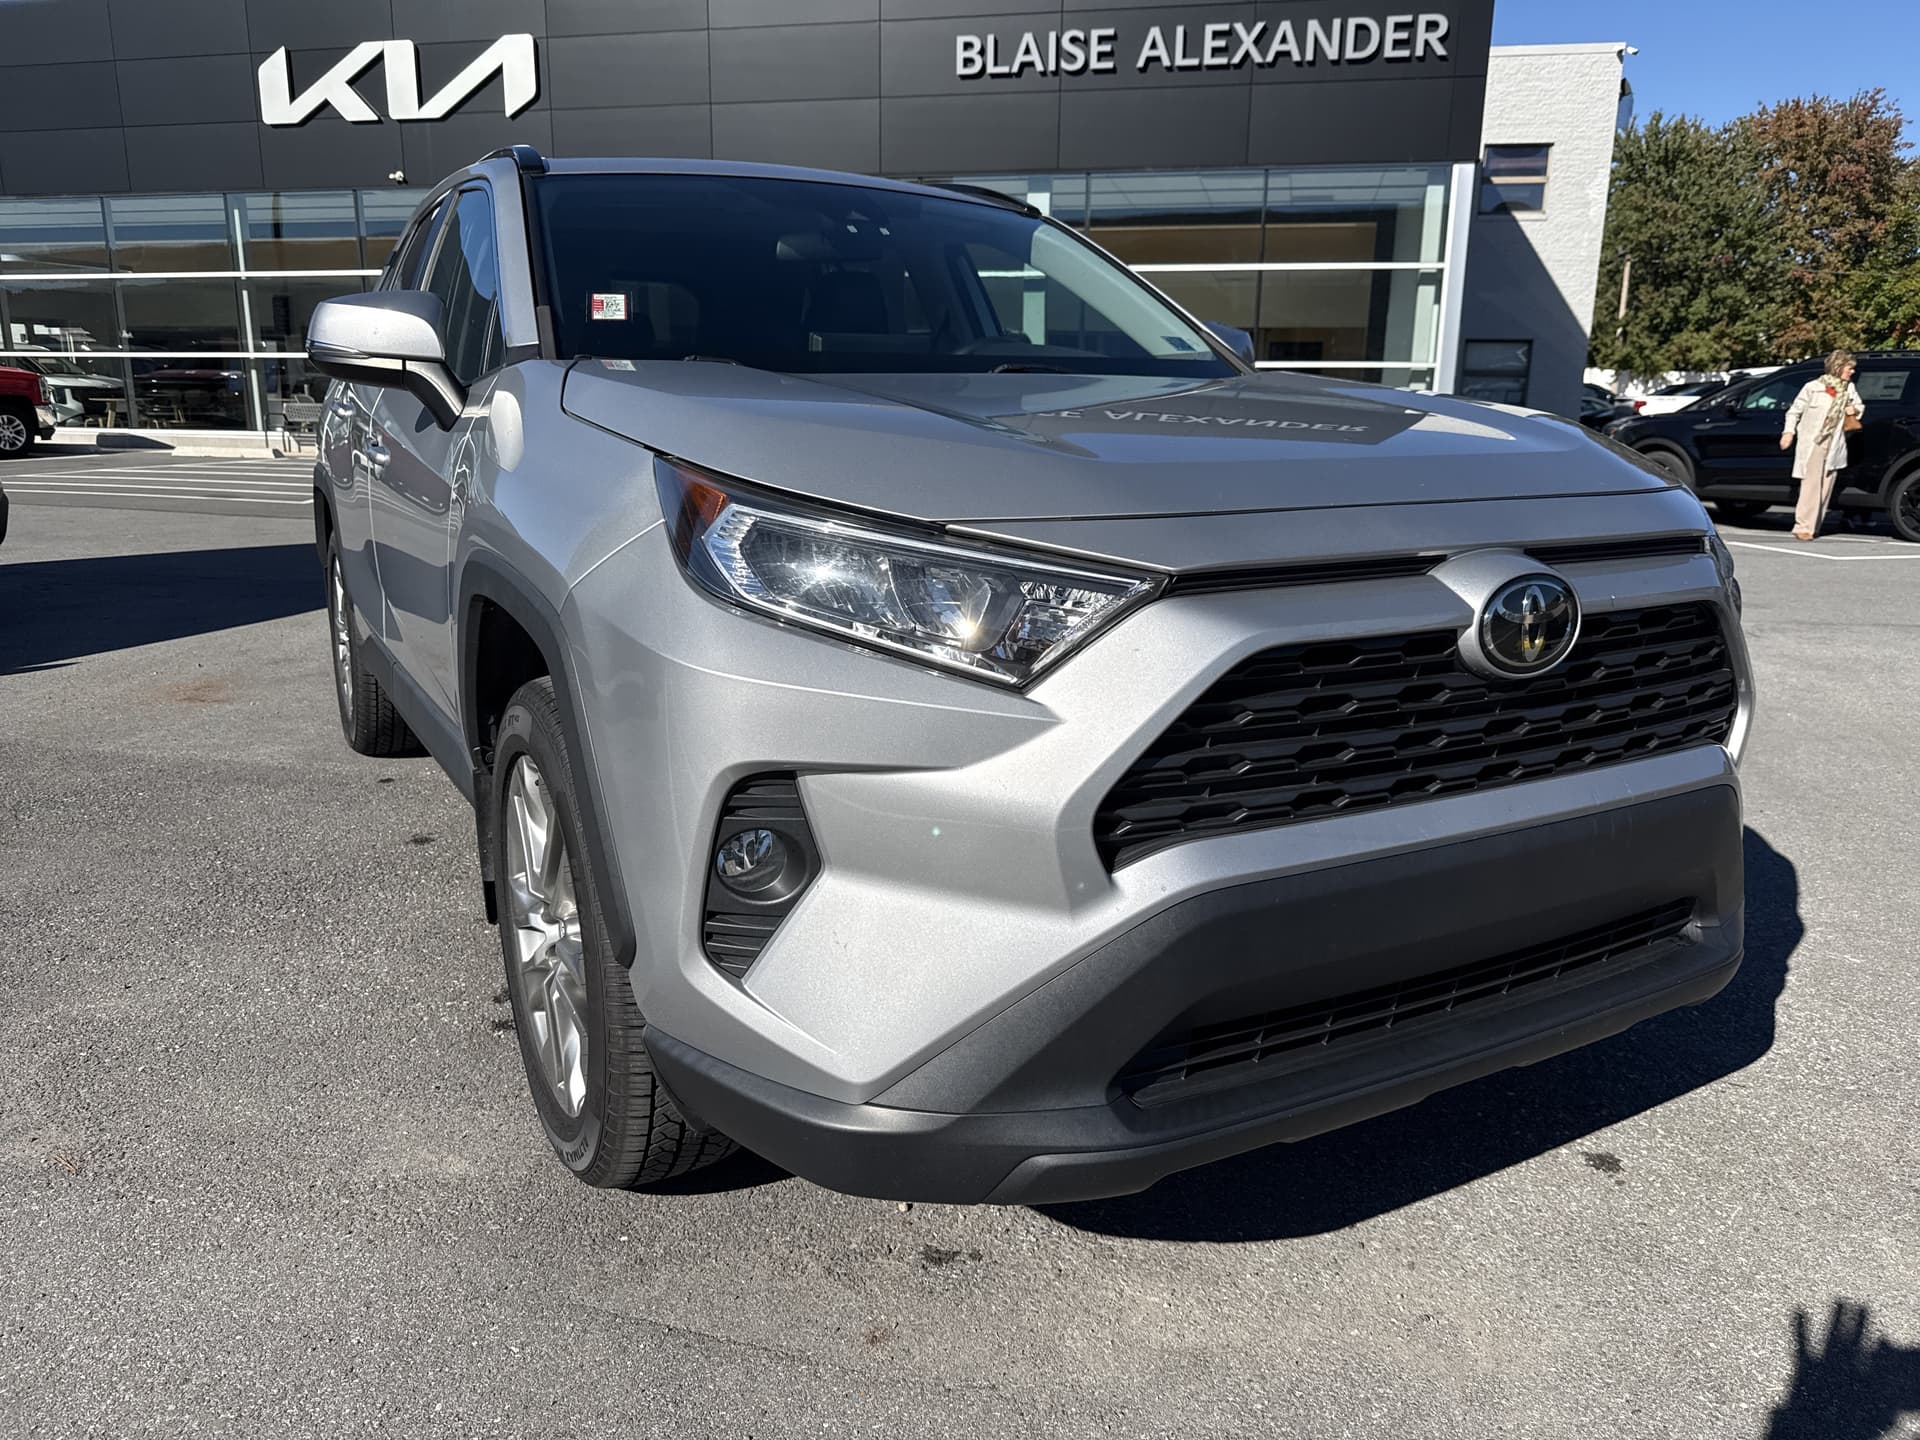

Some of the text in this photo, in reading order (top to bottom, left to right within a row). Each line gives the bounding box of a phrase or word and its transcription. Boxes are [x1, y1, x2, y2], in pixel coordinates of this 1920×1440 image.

[258, 33, 536, 124] KIA
[956, 14, 1448, 75] BLAISE ALEXANDER
